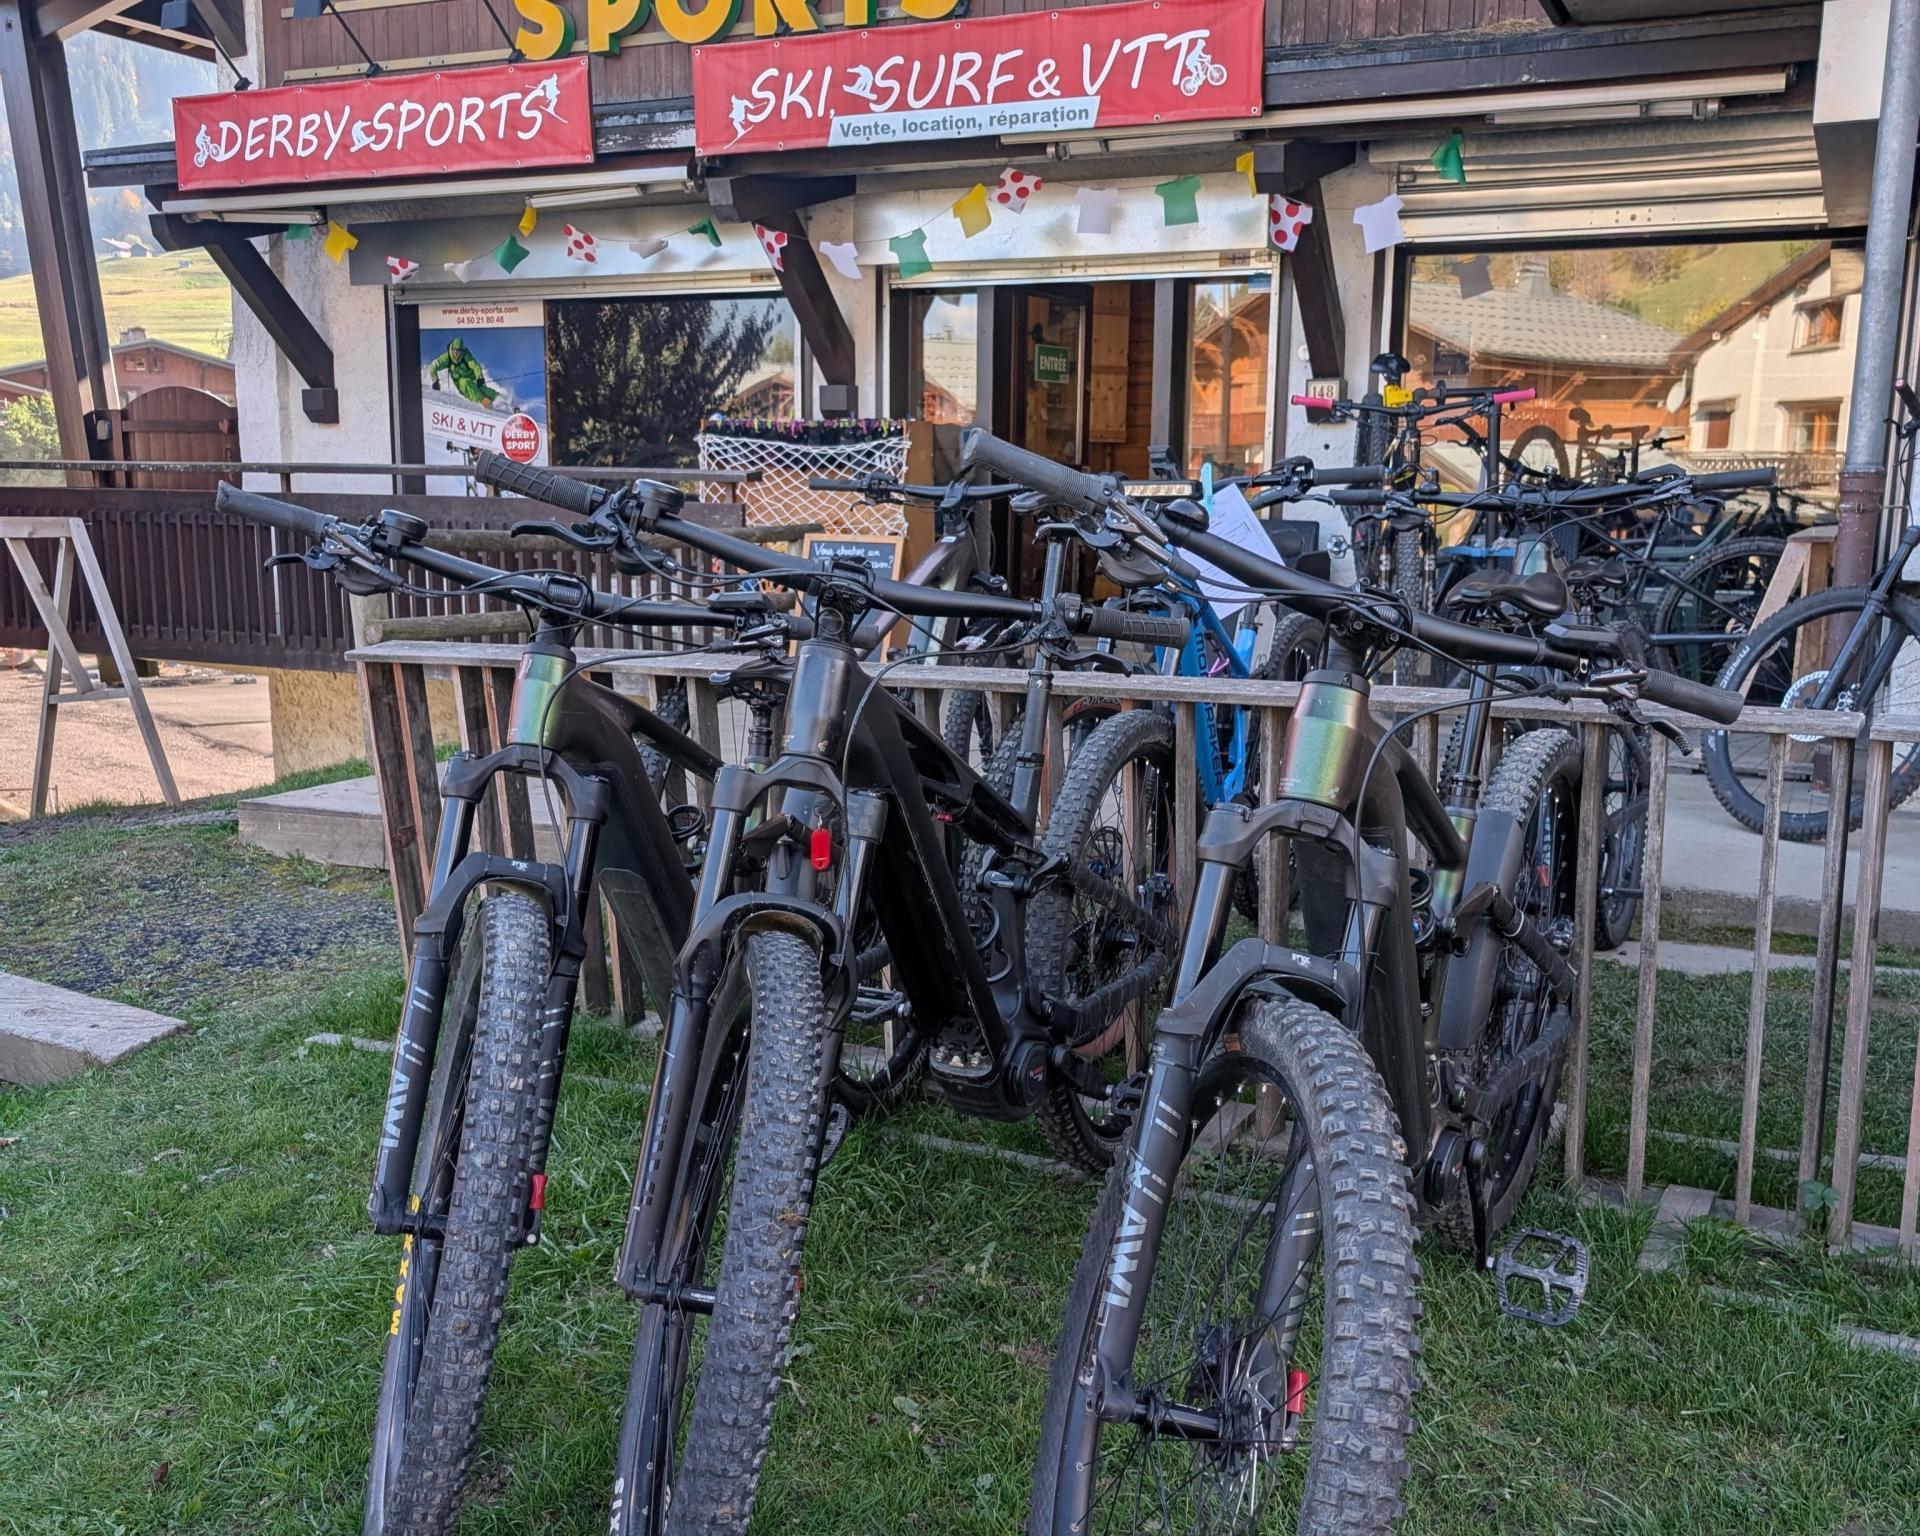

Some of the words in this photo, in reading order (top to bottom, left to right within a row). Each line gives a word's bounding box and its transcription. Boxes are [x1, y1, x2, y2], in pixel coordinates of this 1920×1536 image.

[746, 66, 836, 123] SKI,
[869, 49, 1026, 112] SURF
[1027, 58, 1061, 98] &
[1082, 29, 1211, 96] VTT
[217, 105, 351, 163] DERBY
[368, 89, 546, 153] SPORTS
[839, 119, 897, 138] Vente,
[902, 114, 983, 134] location,
[988, 105, 1091, 130] réparation
[441, 305, 519, 317] www.derby-sports.com
[456, 316, 466, 325] 04
[476, 316, 485, 325] 21
[1039, 353, 1067, 373] ENTRÉE
[1311, 385, 1334, 398] 148
[432, 411, 454, 429] SKI
[457, 417, 467, 432] &
[470, 420, 496, 438] VTT
[504, 430, 536, 439] DERBY
[505, 440, 537, 451] SPORT
[389, 1192, 421, 1336] MAXXS
[609, 1477, 625, 1536] XIS
